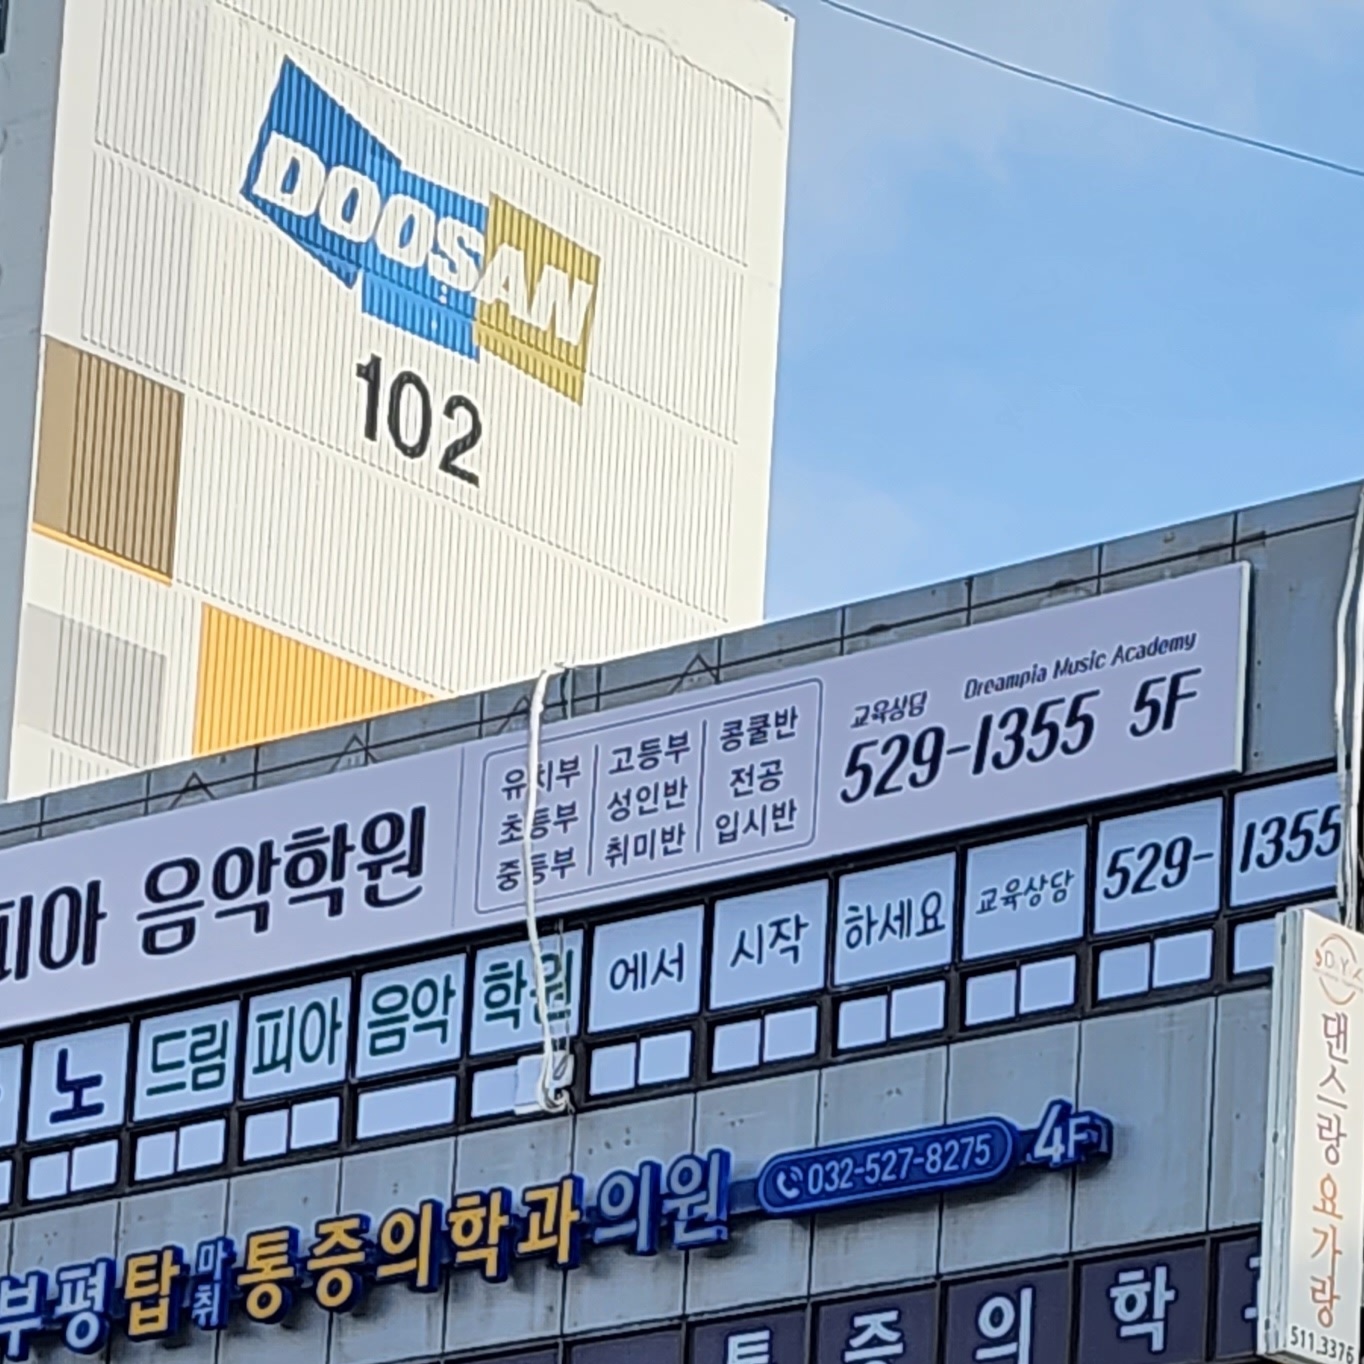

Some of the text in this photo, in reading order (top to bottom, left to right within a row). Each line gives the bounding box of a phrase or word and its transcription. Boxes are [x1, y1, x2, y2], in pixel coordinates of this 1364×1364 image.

[250, 133, 594, 345] DOOSAN
[355, 354, 482, 487] 102
[964, 633, 1197, 700] Dreampia Music Academy
[719, 706, 799, 752] 콩쿨반
[840, 668, 1202, 803] 529-1355 5F
[850, 691, 928, 729] 교육상담
[608, 731, 691, 775] 고등부
[730, 759, 784, 798] 전공
[498, 802, 578, 845] 초등부
[606, 777, 688, 823] 성인반
[716, 799, 797, 845] 입시반
[496, 847, 576, 891] 중등부
[605, 823, 686, 868] 취미반
[137, 805, 426, 956] 음악학원
[50, 1048, 104, 1124] 노
[608, 940, 687, 992] 에서
[730, 913, 811, 969] 시작
[844, 892, 945, 950] 하세요
[975, 869, 1075, 915] 교육상담
[1316, 1011, 1349, 1166] 댄스랑
[1034, 1104, 1091, 1162] 4F
[806, 1132, 992, 1196] 032-527-8275
[1310, 1173, 1343, 1329] 요가랑
